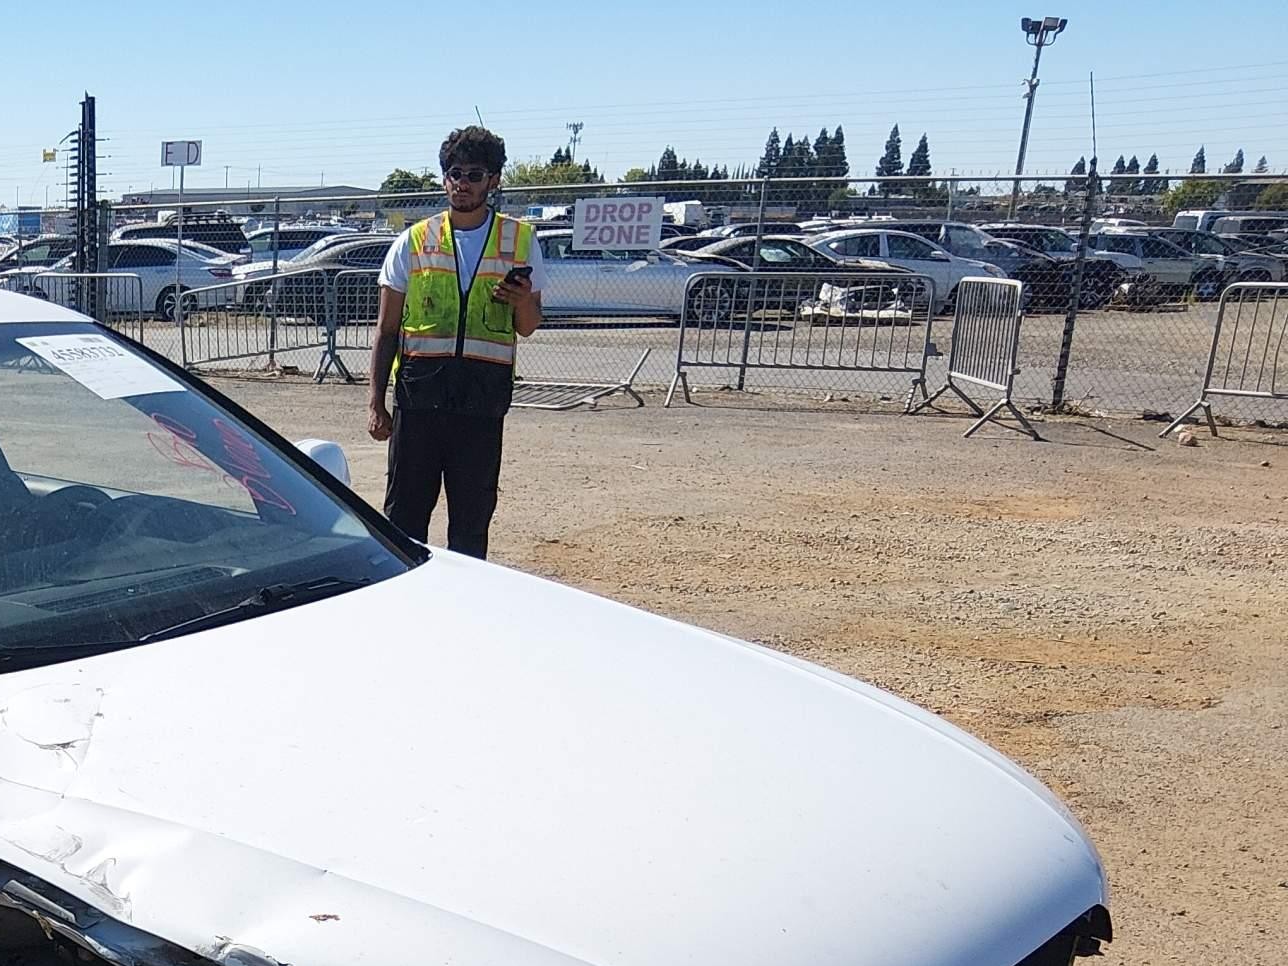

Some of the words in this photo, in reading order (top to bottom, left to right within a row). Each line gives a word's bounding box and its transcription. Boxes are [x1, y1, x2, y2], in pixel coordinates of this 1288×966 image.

[584, 202, 653, 224] DROP
[582, 224, 651, 245] ZONE
[49, 345, 125, 362] 45583732
